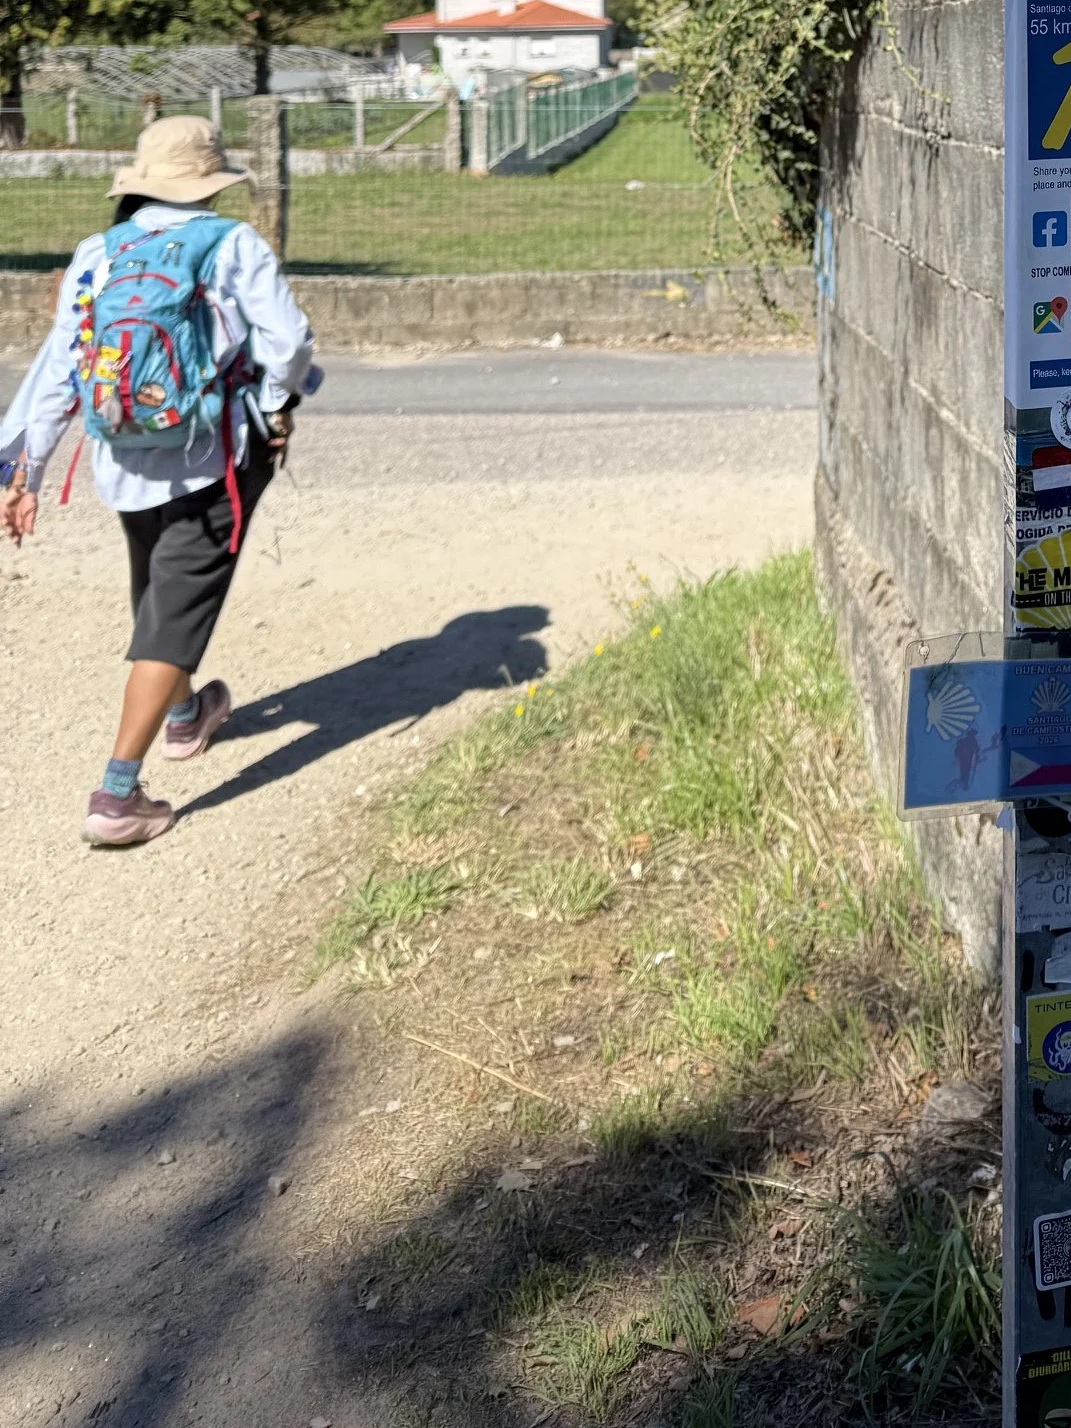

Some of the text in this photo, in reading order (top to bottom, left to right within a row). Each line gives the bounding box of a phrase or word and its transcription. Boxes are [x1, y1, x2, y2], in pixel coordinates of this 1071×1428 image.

[1030, 3, 1066, 15] Santiago
[1030, 19, 1048, 35] 55
[1033, 166, 1057, 176] Share
[1033, 180, 1055, 191] place
[1057, 179, 1071, 189] and
[1031, 267, 1051, 278] STOP
[1033, 368, 1060, 378] Please,
[1044, 592, 1057, 605] ON
[1015, 665, 1045, 675] BUEN
